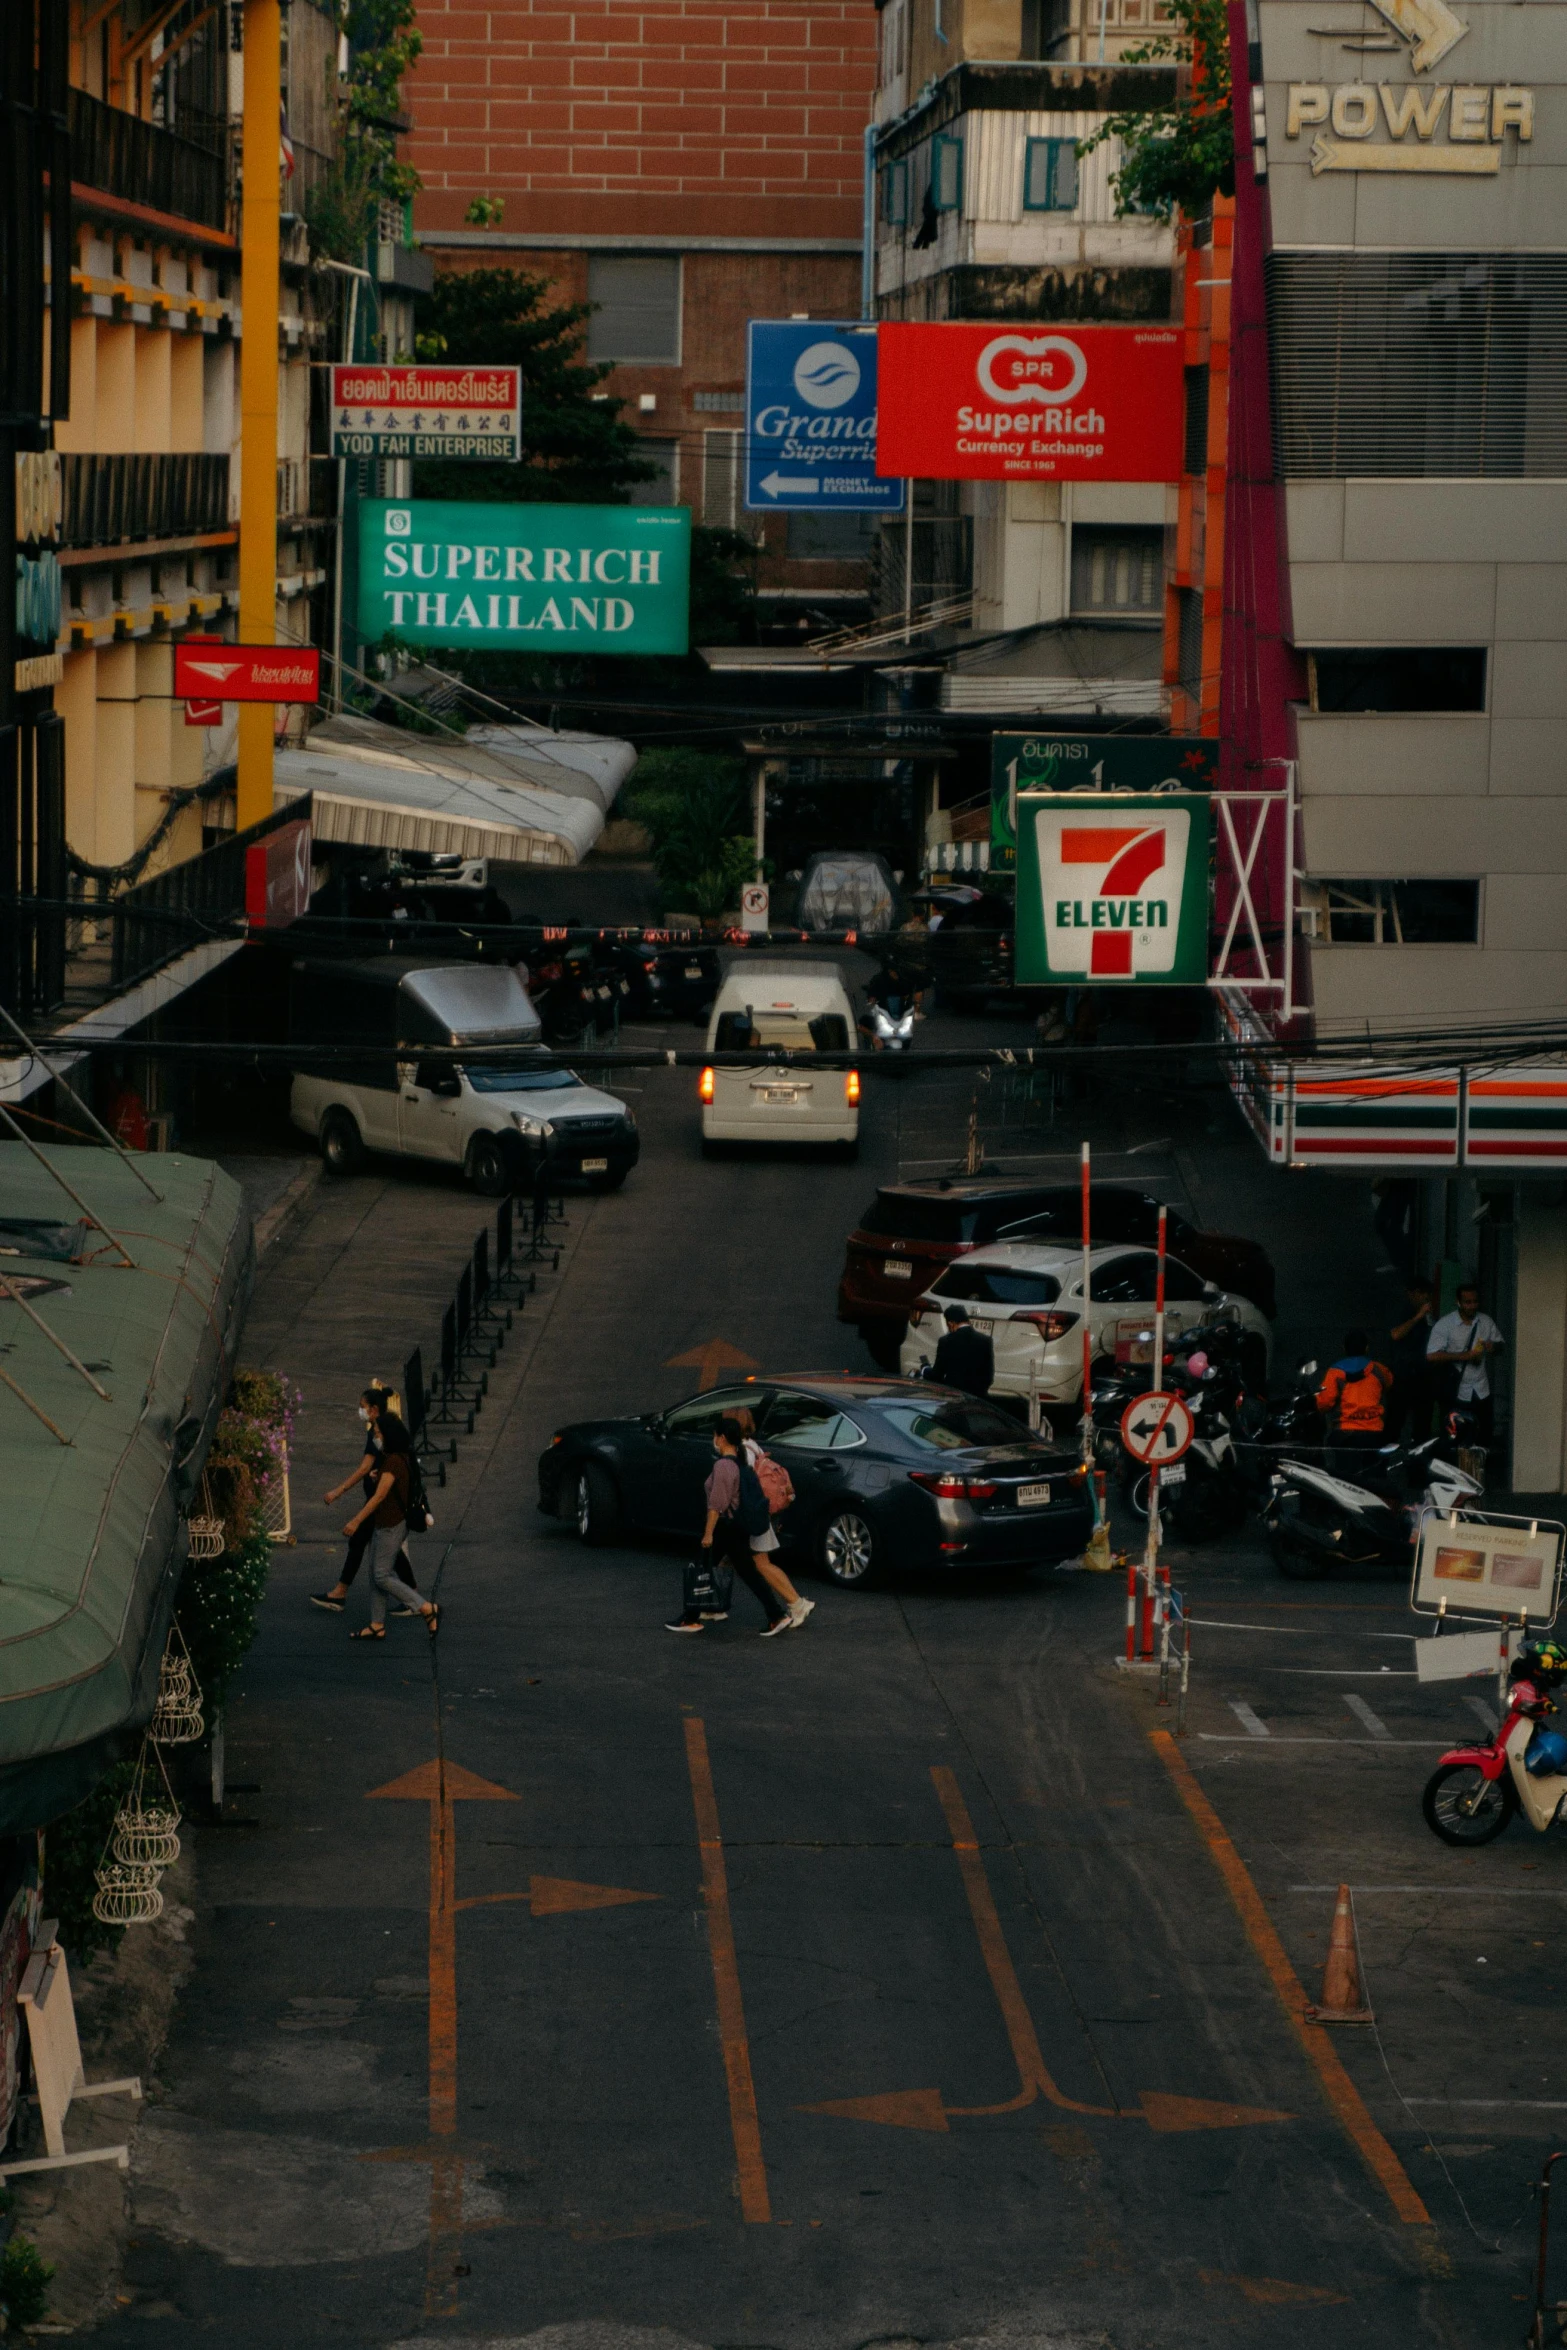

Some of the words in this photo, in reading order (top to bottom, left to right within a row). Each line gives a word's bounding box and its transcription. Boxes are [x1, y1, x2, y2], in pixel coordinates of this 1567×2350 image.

[1286, 84, 1535, 141] POWER
[1010, 361, 1054, 378] SPR
[755, 405, 878, 438] Grand
[957, 406, 1106, 438] SuperRich
[340, 436, 374, 454] YOD
[379, 437, 410, 455] FAH
[414, 438, 513, 456] ENTERPRISE
[957, 438, 1025, 456] Currency
[1031, 440, 1104, 459] Exchange
[1004, 460, 1032, 470] SINCE
[823, 477, 869, 486] MONEY
[823, 485, 890, 494] EXCHANGE
[384, 542, 663, 585] SUPERRICH
[384, 590, 635, 632] THAILAND
[1455, 1532, 1493, 1544] RESERVED
[1494, 1536, 1528, 1548] PARKING
